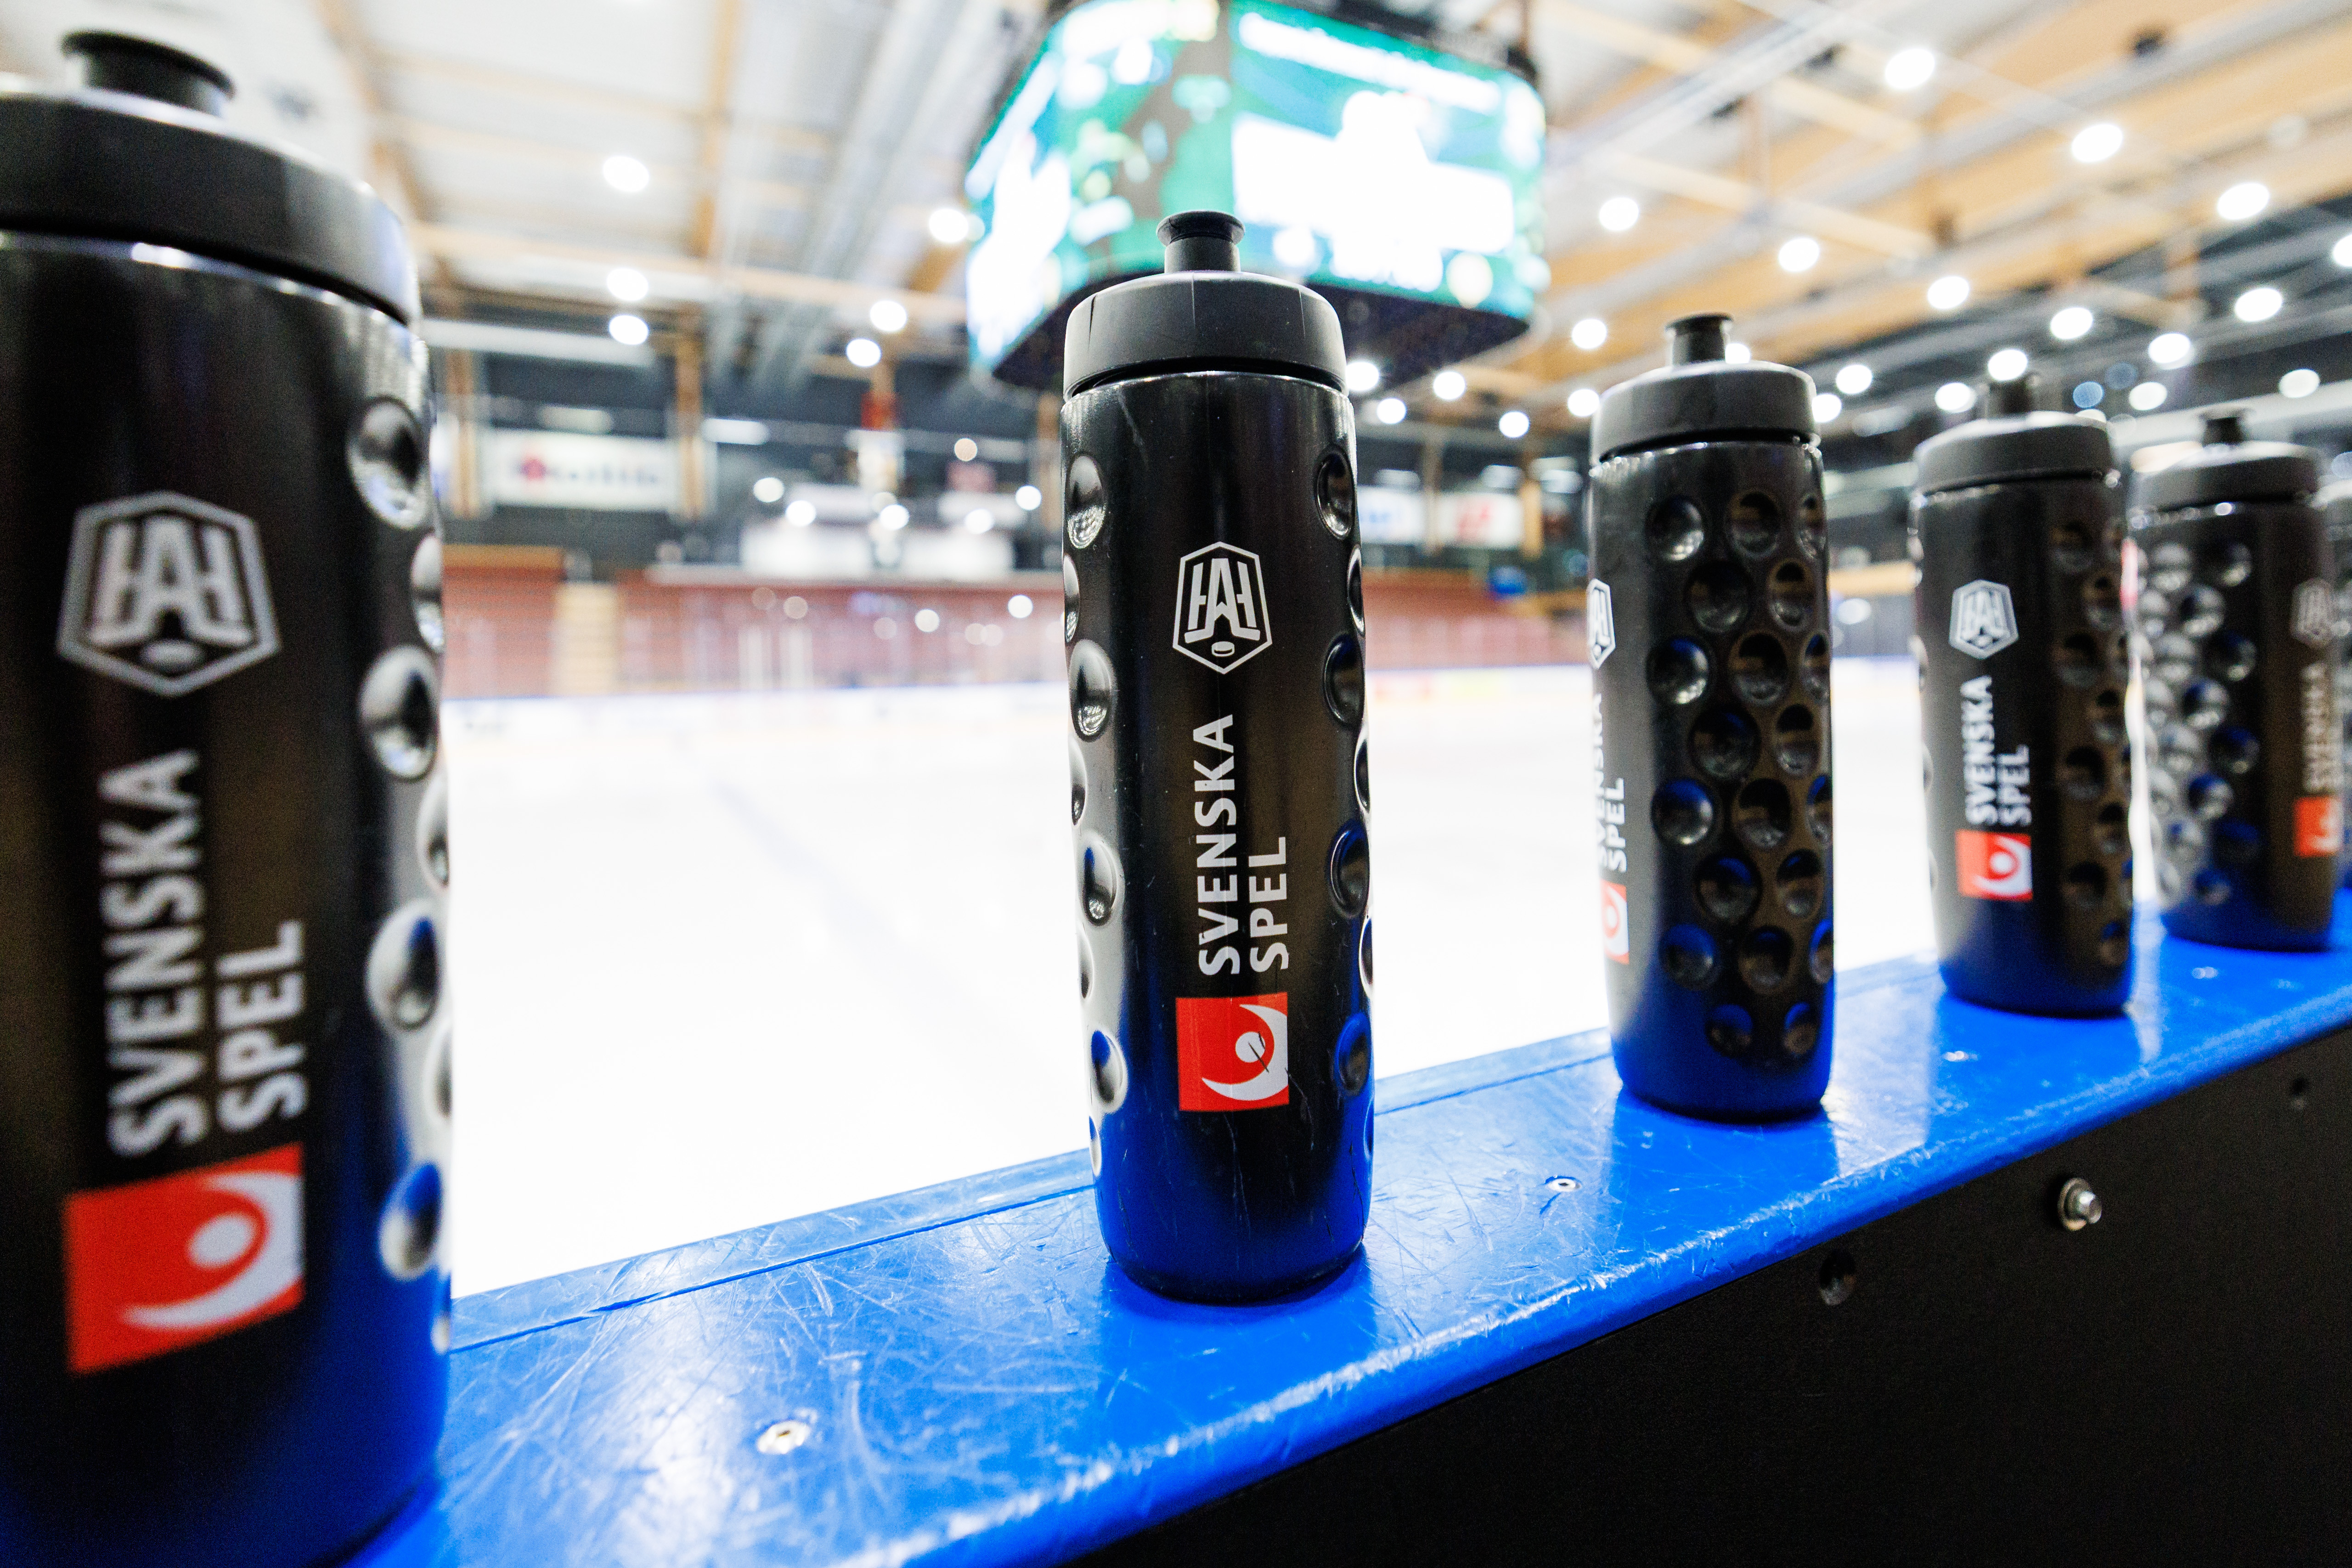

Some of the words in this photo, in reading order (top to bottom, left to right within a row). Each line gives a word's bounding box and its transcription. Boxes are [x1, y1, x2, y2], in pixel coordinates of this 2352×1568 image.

[1606, 777, 1627, 873] SPEL
[1960, 675, 1997, 825] SVENSKA
[1997, 744, 2032, 826] SPEL
[1193, 714, 1240, 976] SVENSKA
[1248, 836, 1289, 972] SPEL
[101, 750, 207, 1156] SVENSKA
[217, 920, 307, 1133] SPEL
